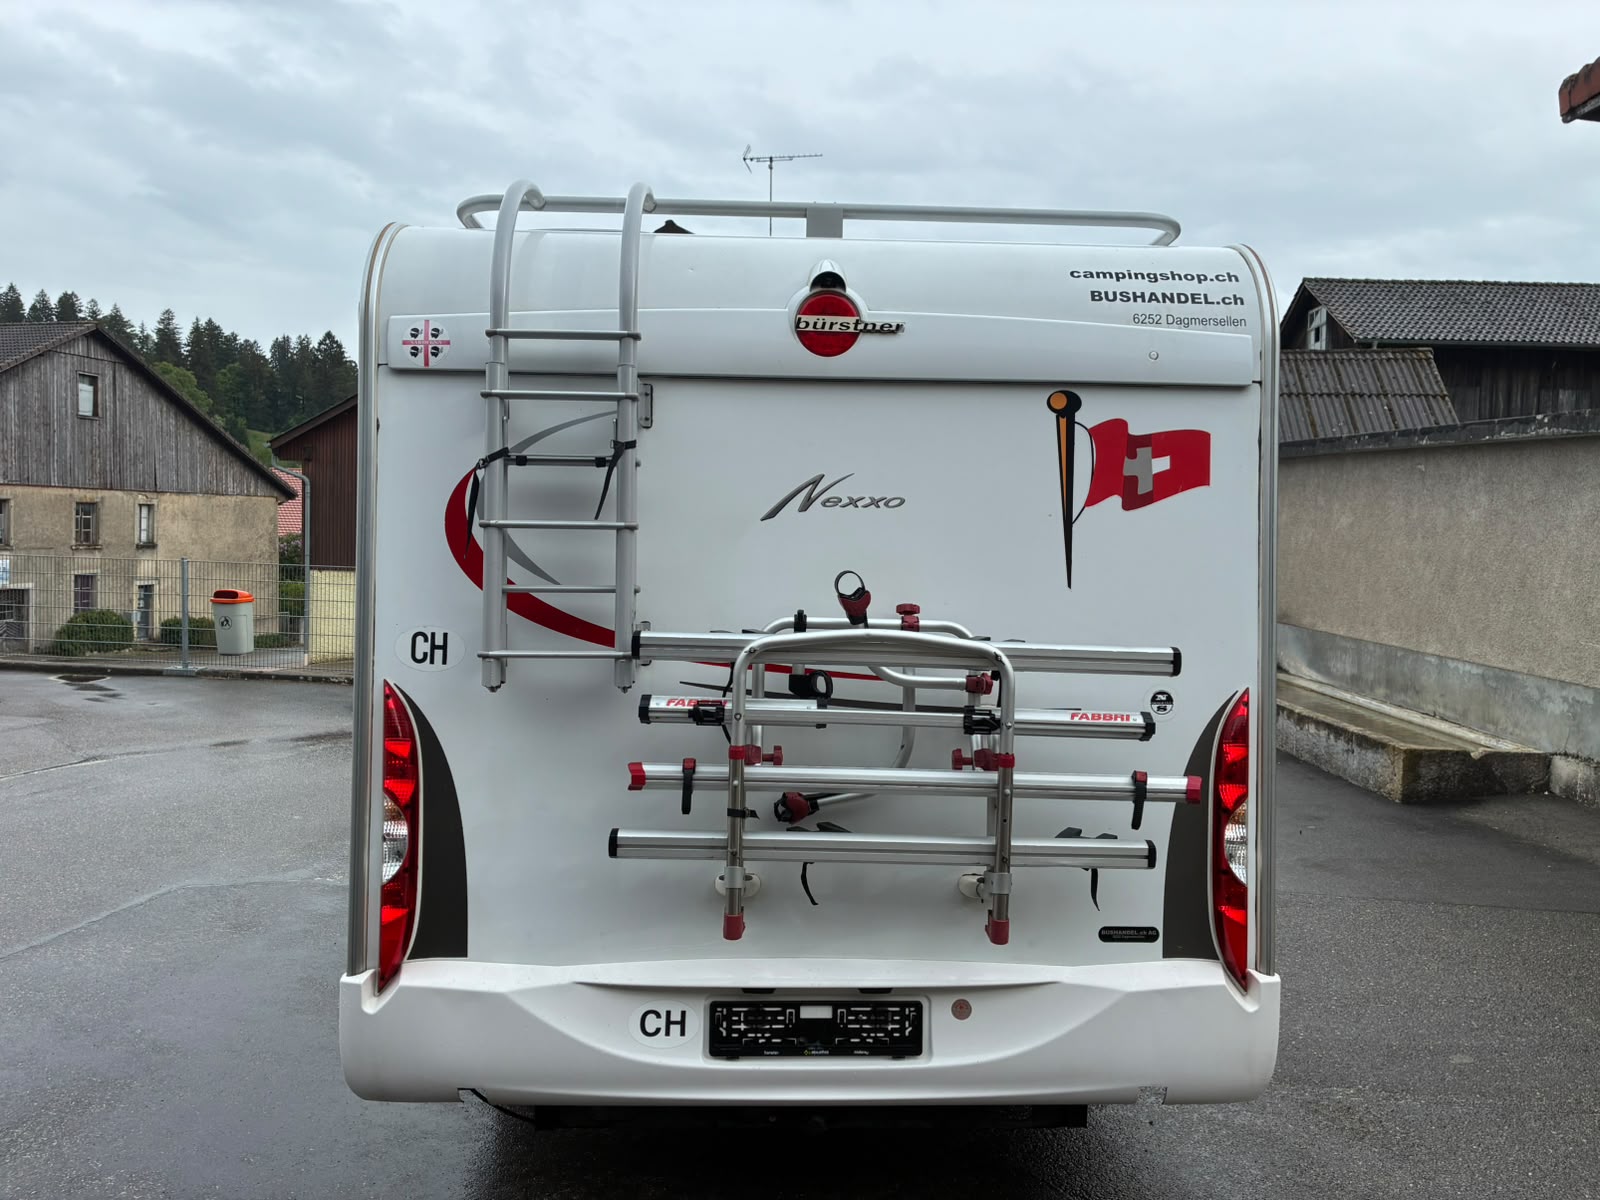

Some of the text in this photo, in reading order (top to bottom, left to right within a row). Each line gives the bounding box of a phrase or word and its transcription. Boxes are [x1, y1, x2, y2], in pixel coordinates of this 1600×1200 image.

[1069, 270, 1240, 284] campingshop.ch
[1090, 290, 1245, 306] BUSHANDEL.ch
[796, 317, 905, 333] bürstner
[1132, 313, 1247, 329] 6252 Dagmersellen
[760, 472, 906, 522] Nexxo
[411, 631, 448, 665] CH
[1070, 712, 1131, 722] FABBRI
[640, 1009, 687, 1037] CH
